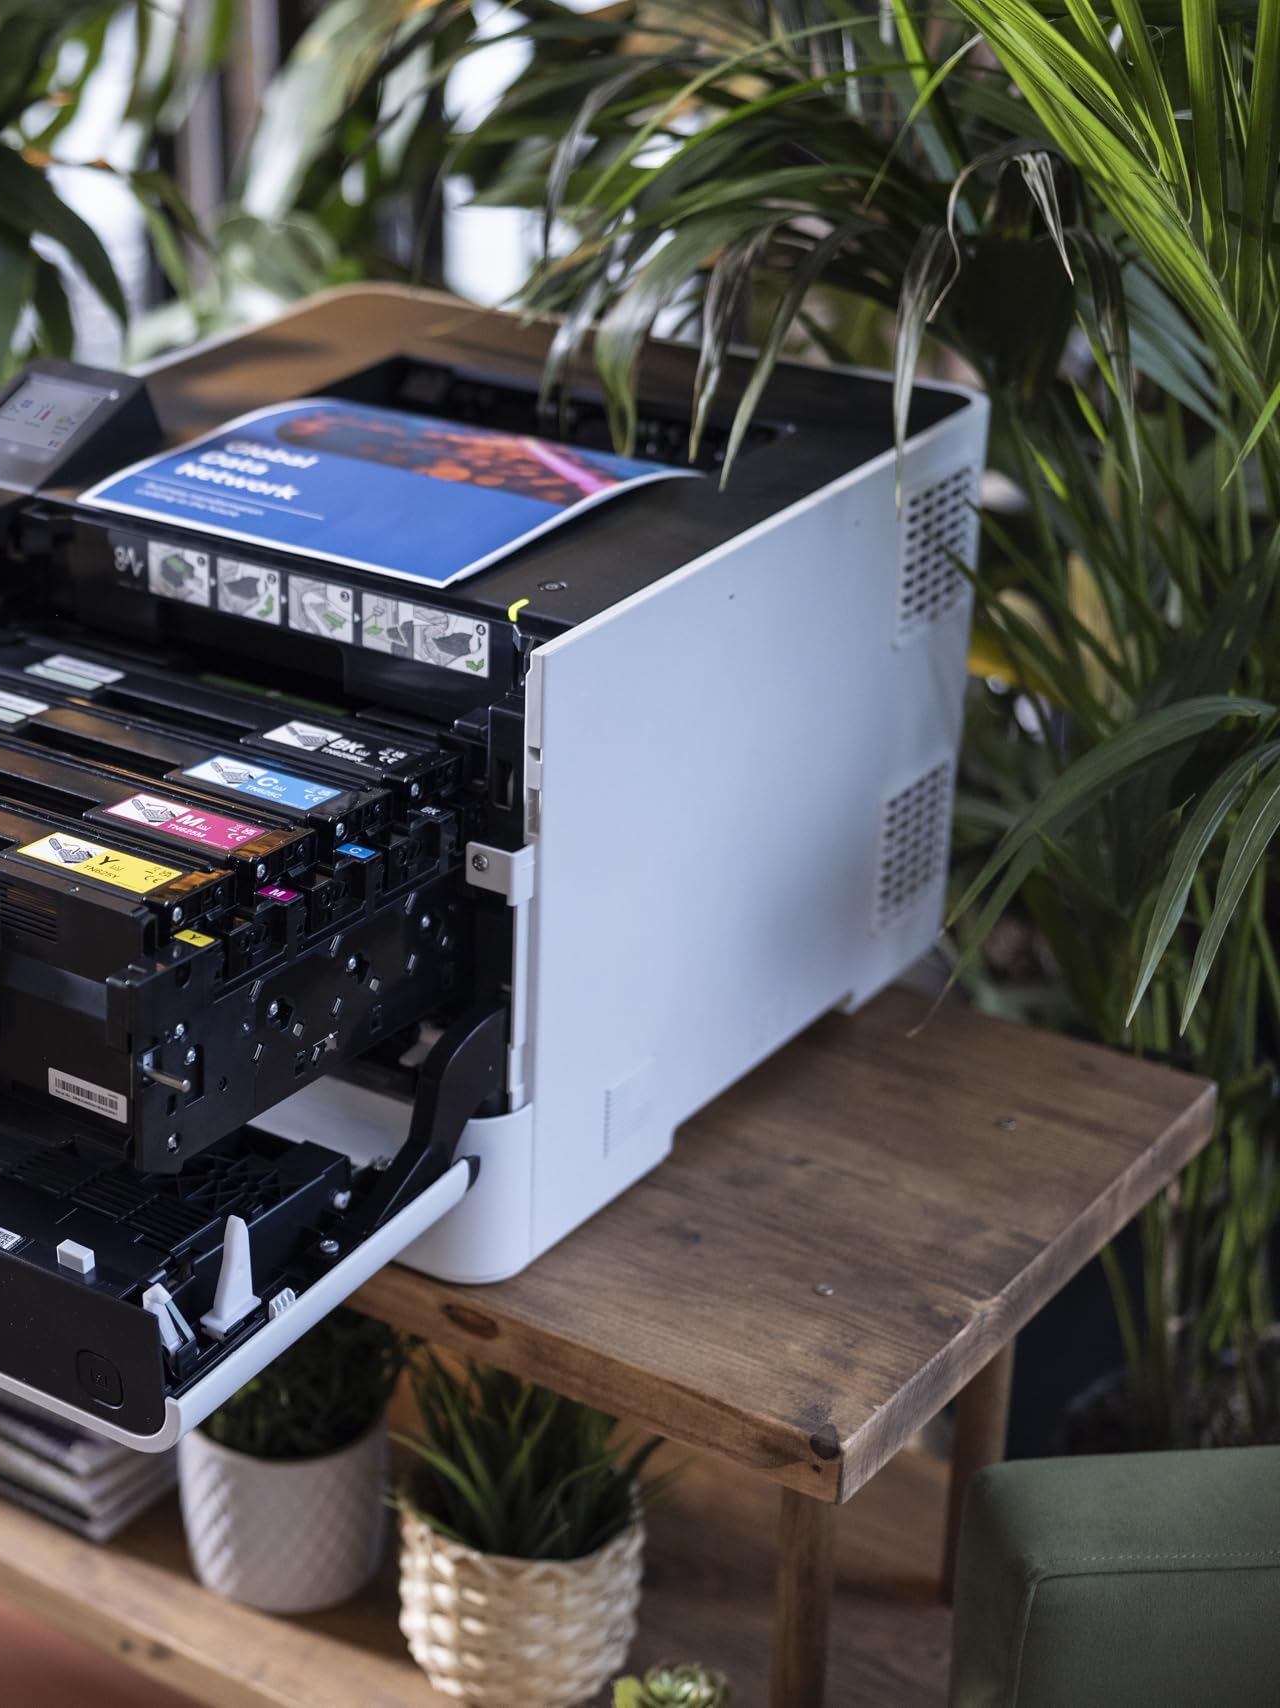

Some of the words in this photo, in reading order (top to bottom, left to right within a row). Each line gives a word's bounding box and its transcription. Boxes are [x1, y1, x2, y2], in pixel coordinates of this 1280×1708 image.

[224, 440, 319, 470] Global
[199, 450, 268, 476] Data
[174, 462, 300, 501] Network
[328, 739, 365, 753] BK
[257, 777, 279, 787] C
[245, 784, 282, 799] TN625C
[420, 806, 440, 815] BK
[176, 814, 207, 827] M
[167, 823, 207, 838] TN625M
[99, 856, 120, 866] Y
[83, 865, 120, 879] TN625Y
[268, 888, 286, 897] M
